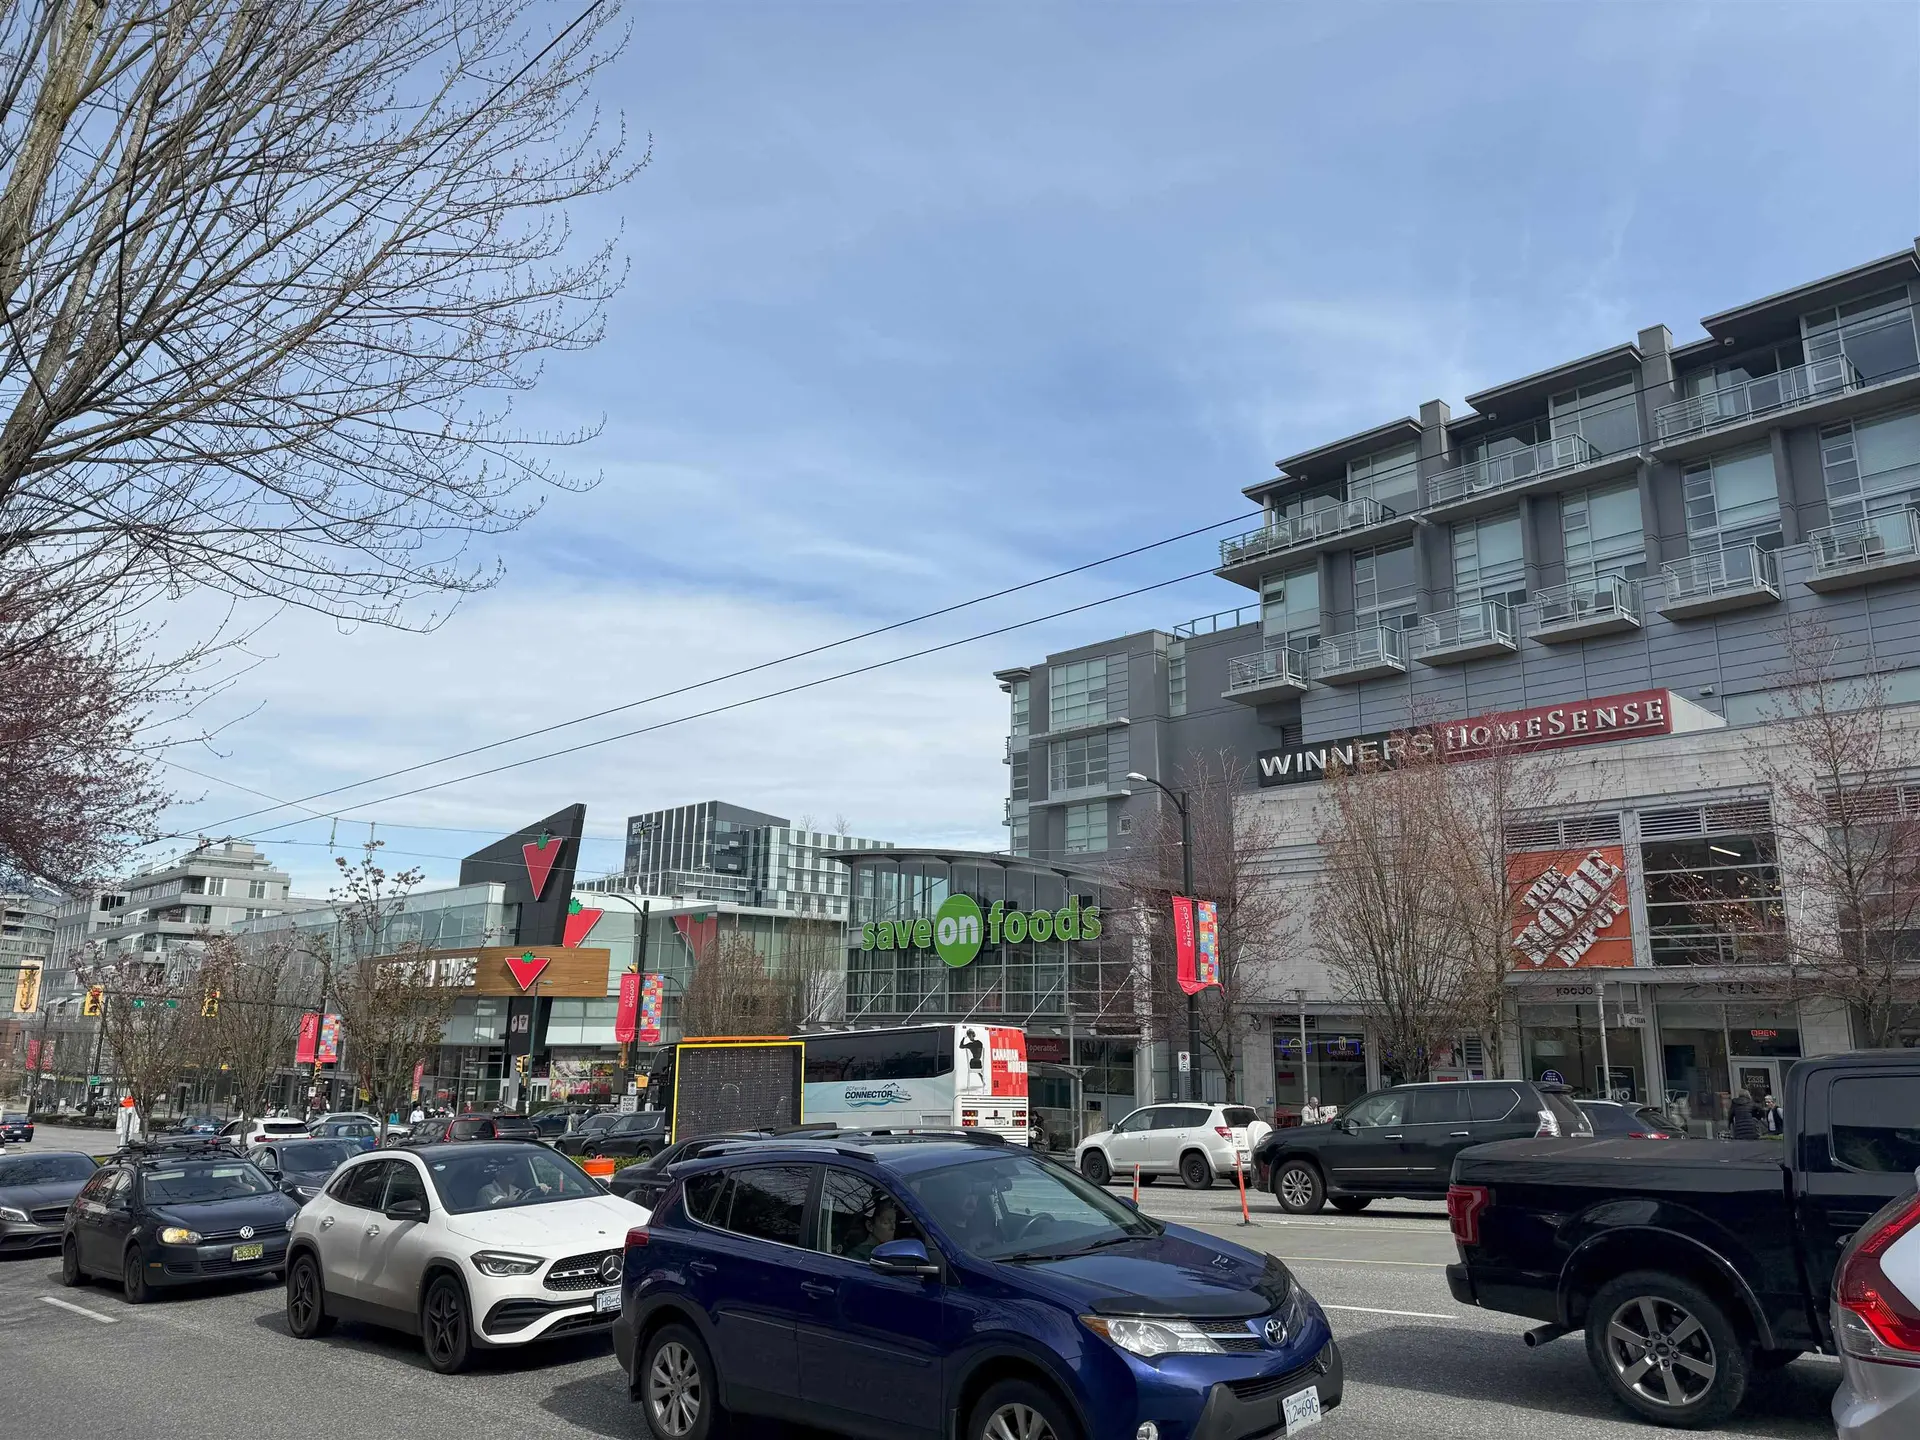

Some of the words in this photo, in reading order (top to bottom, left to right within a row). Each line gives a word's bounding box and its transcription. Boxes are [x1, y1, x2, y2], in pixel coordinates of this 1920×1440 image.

[1259, 733, 1435, 777] WINNERS
[1511, 849, 1622, 966] HOME
[1520, 865, 1568, 909] THE
[860, 917, 931, 951] save
[937, 913, 979, 946] on
[988, 894, 1102, 944] foods
[1556, 892, 1625, 967] DEPOT
[1750, 1029, 1777, 1037] OPEN
[844, 1090, 893, 1099] CONNECTOR
